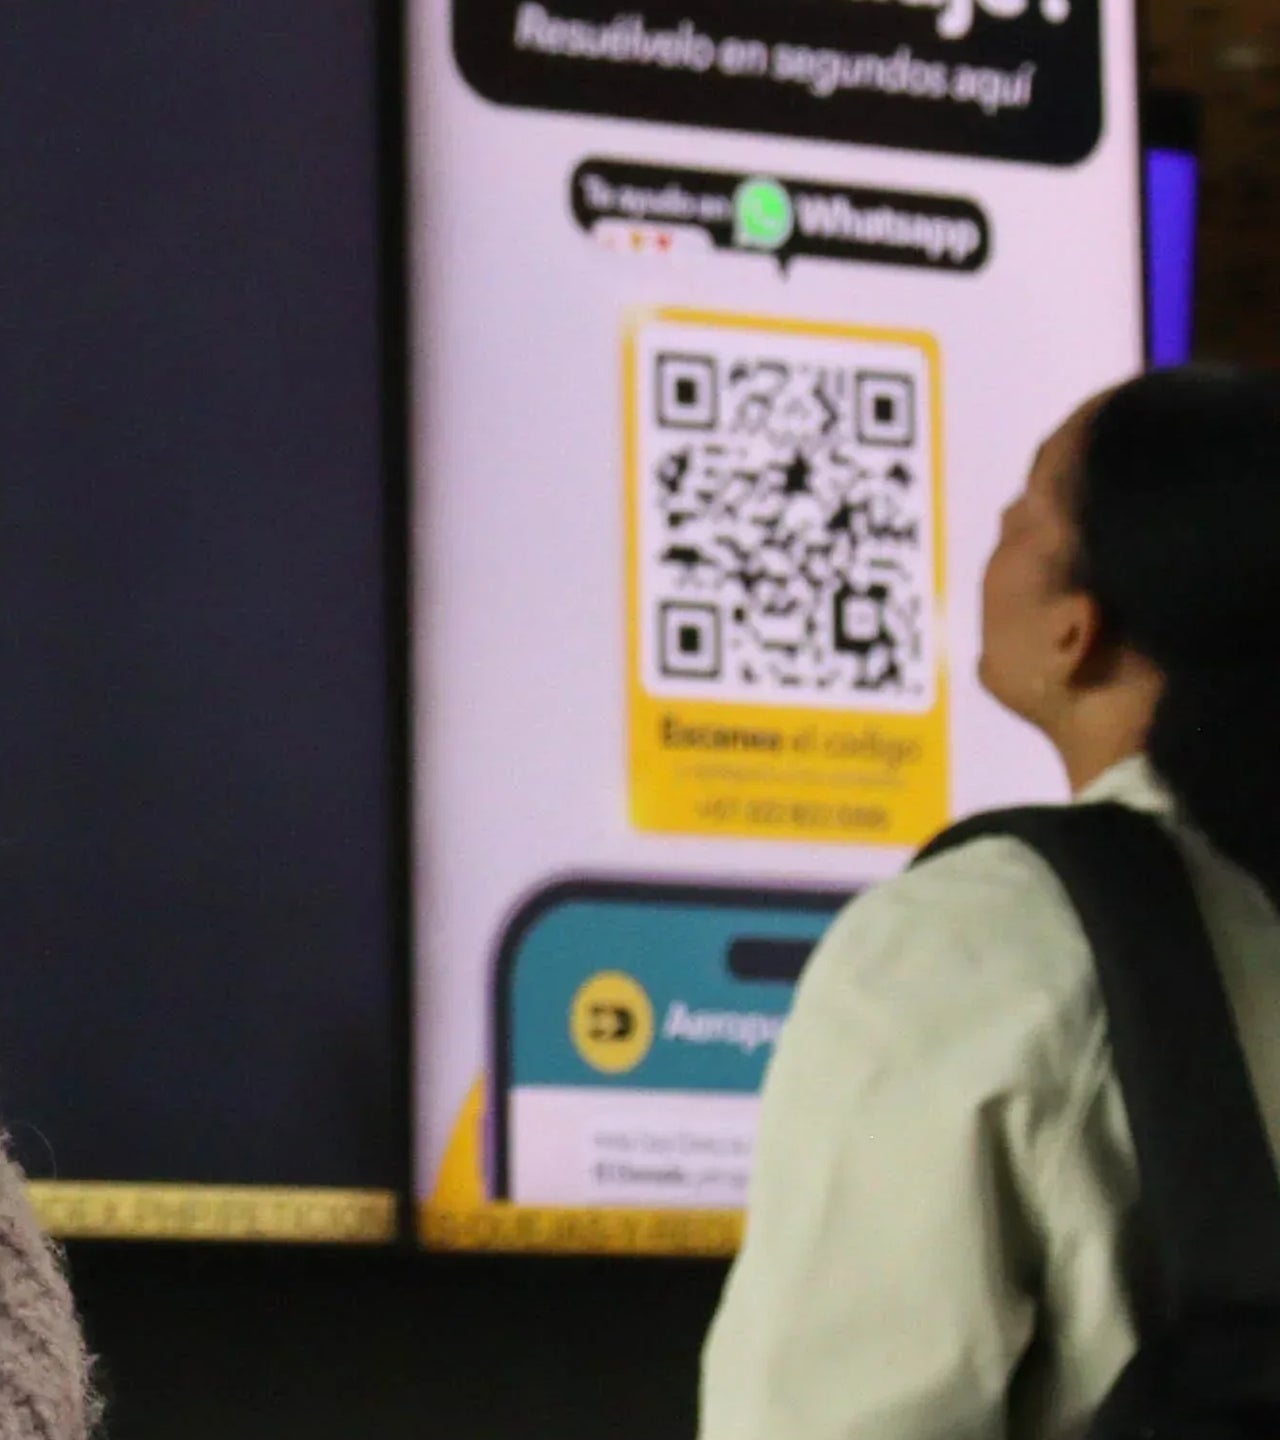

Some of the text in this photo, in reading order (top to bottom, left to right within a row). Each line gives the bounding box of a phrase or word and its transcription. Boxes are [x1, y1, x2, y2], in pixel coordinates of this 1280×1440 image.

[514, 1, 1037, 116] Resuélvelo en segundos aquí
[795, 193, 982, 264] Whatsapp
